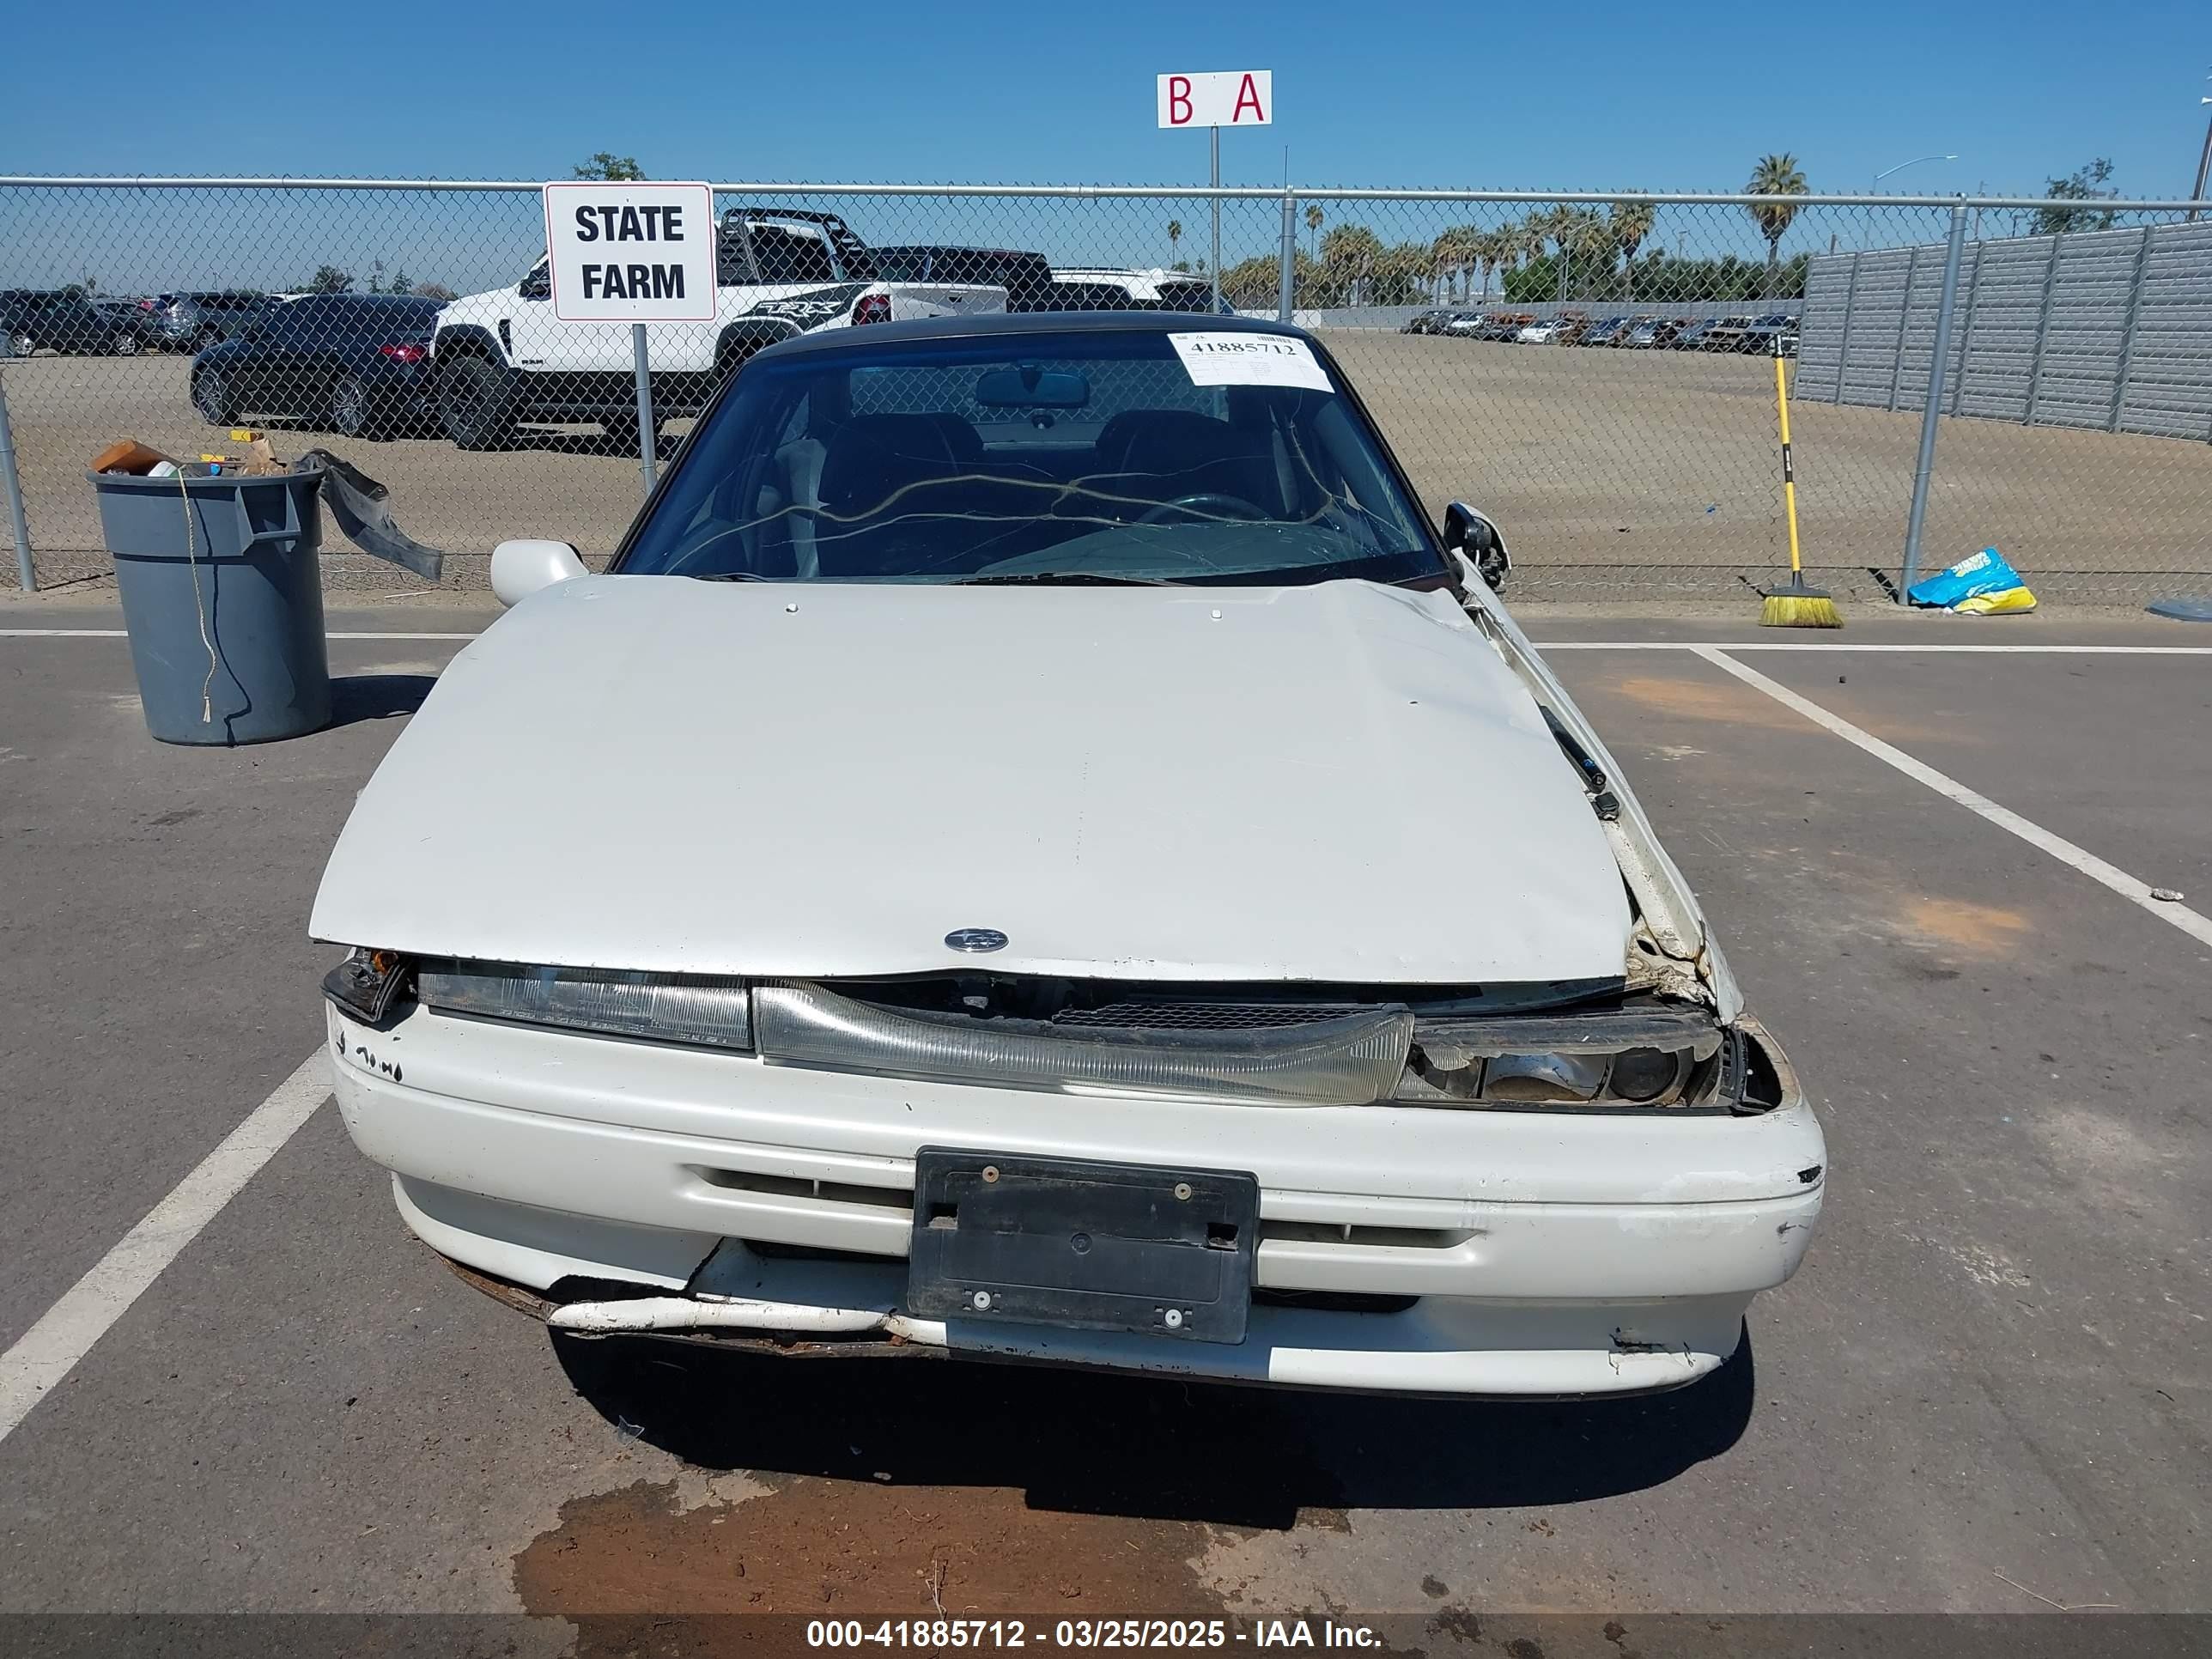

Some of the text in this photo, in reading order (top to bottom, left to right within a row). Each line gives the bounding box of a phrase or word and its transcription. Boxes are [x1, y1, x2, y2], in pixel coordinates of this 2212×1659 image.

[1169, 73, 1265, 125] B A
[574, 204, 684, 242] STATE
[581, 264, 685, 299] FARM
[1190, 342, 1298, 356] 41885712
